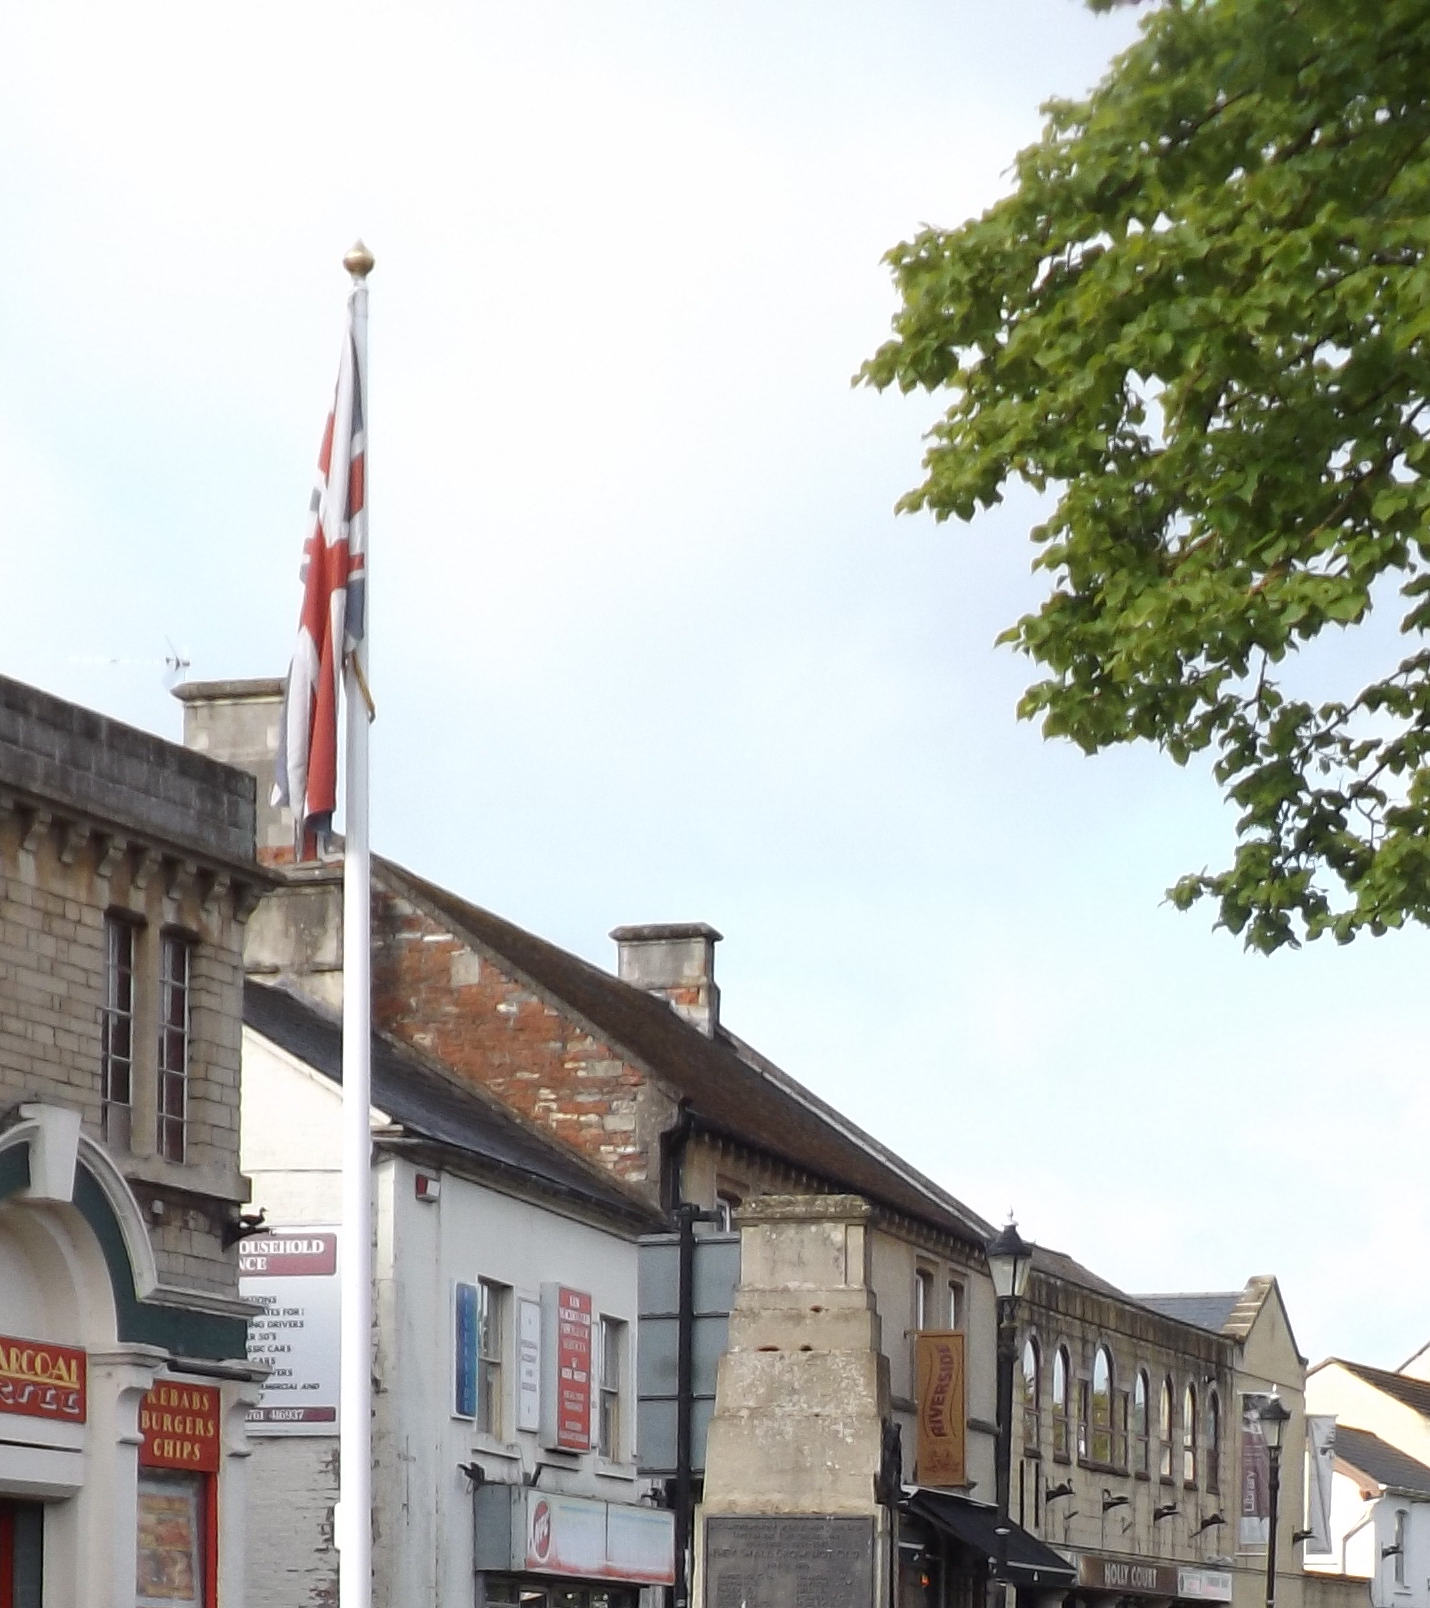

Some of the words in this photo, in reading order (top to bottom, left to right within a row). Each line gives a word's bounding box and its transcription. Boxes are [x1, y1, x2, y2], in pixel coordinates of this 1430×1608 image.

[239, 1240, 325, 1254] OUSEHOLD
[267, 1320, 304, 1329] DRIVERS
[267, 1345, 292, 1353] CARS
[300, 1382, 320, 1390] AND
[928, 1343, 954, 1438] RIVERSIDE
[146, 1387, 210, 1411] KEBABS
[141, 1410, 215, 1438] BURGERS
[152, 1437, 202, 1461] CHIPS
[1244, 1470, 1257, 1513] Library
[1104, 1562, 1130, 1586] HOLLY
[1130, 1565, 1158, 1589] COURT
